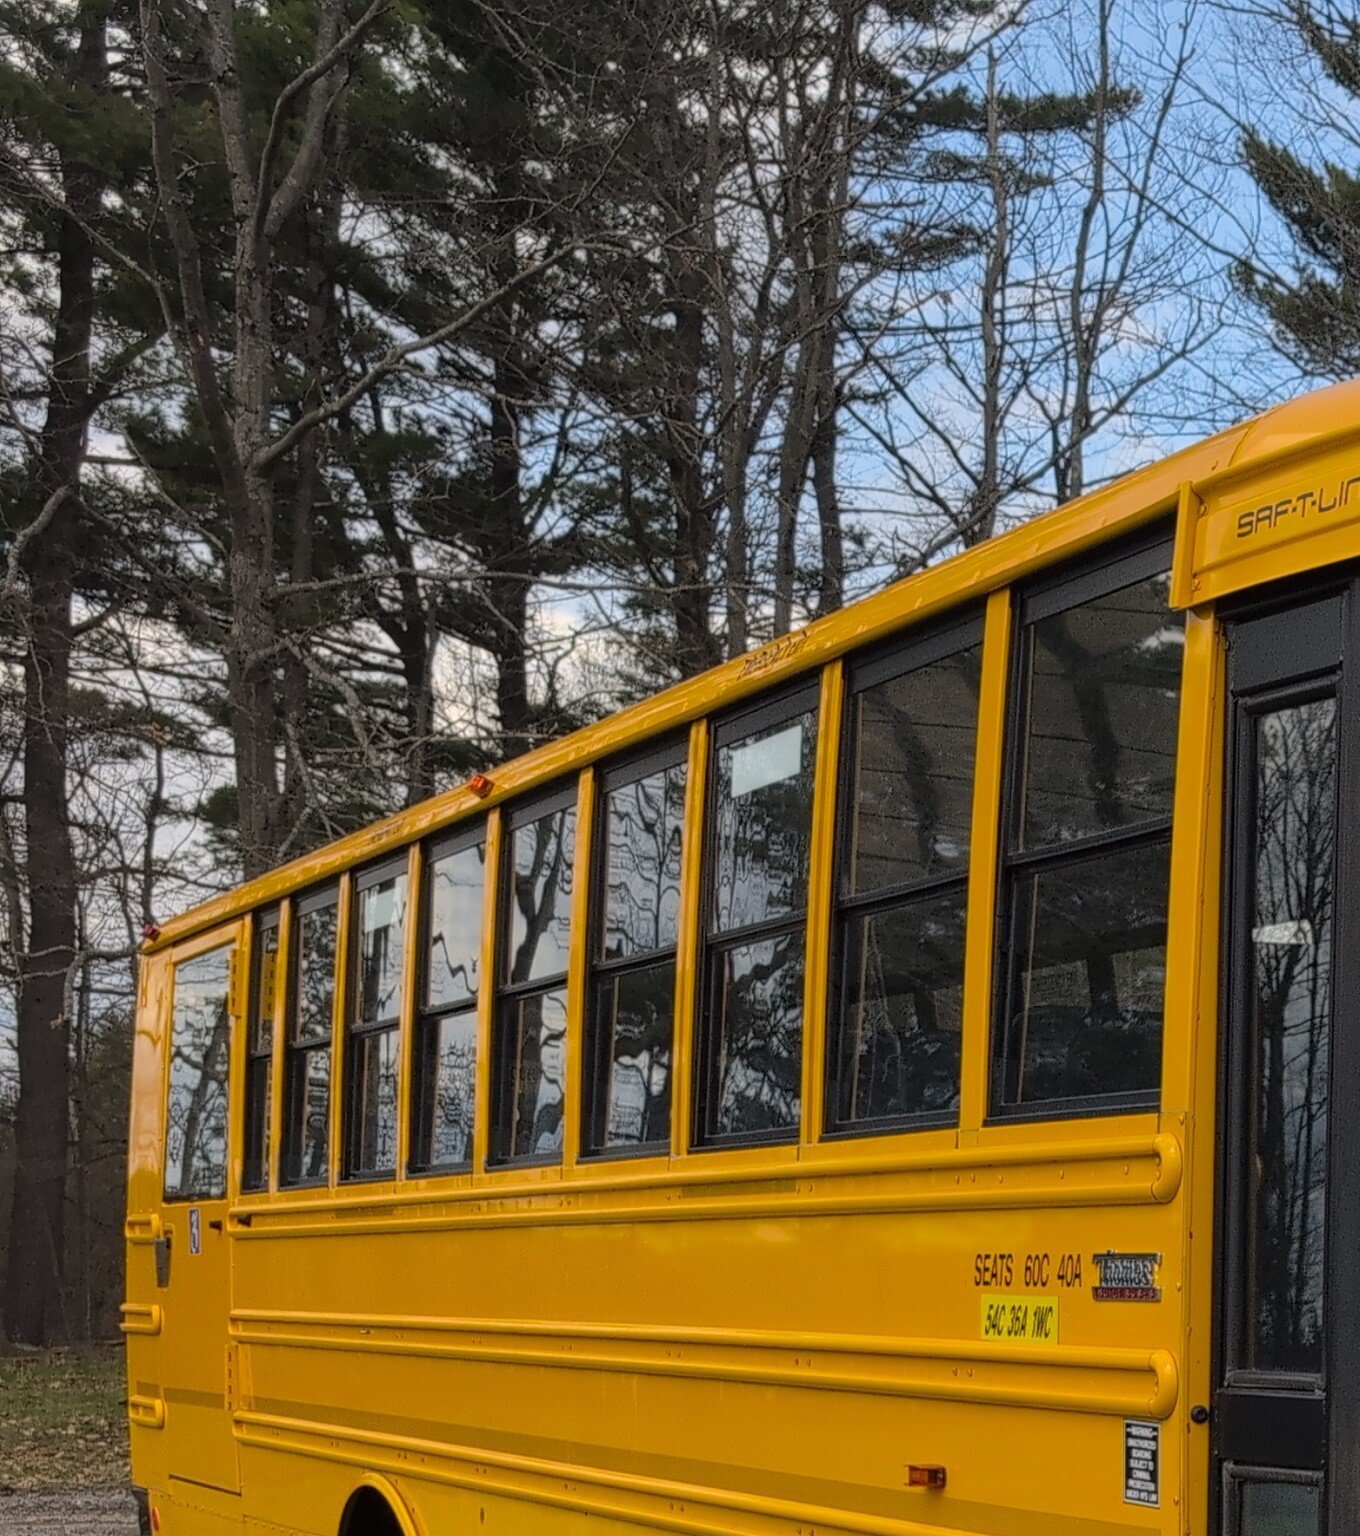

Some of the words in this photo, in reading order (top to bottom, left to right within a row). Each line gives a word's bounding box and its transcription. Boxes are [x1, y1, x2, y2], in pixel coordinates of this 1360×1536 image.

[973, 1253, 1014, 1288] SEATS
[1024, 1253, 1050, 1288] 60C
[1057, 1253, 1083, 1288] 40A
[984, 1304, 1007, 1336] 54C
[1007, 1304, 1029, 1339] 36A
[1031, 1305, 1055, 1340] 1WC
